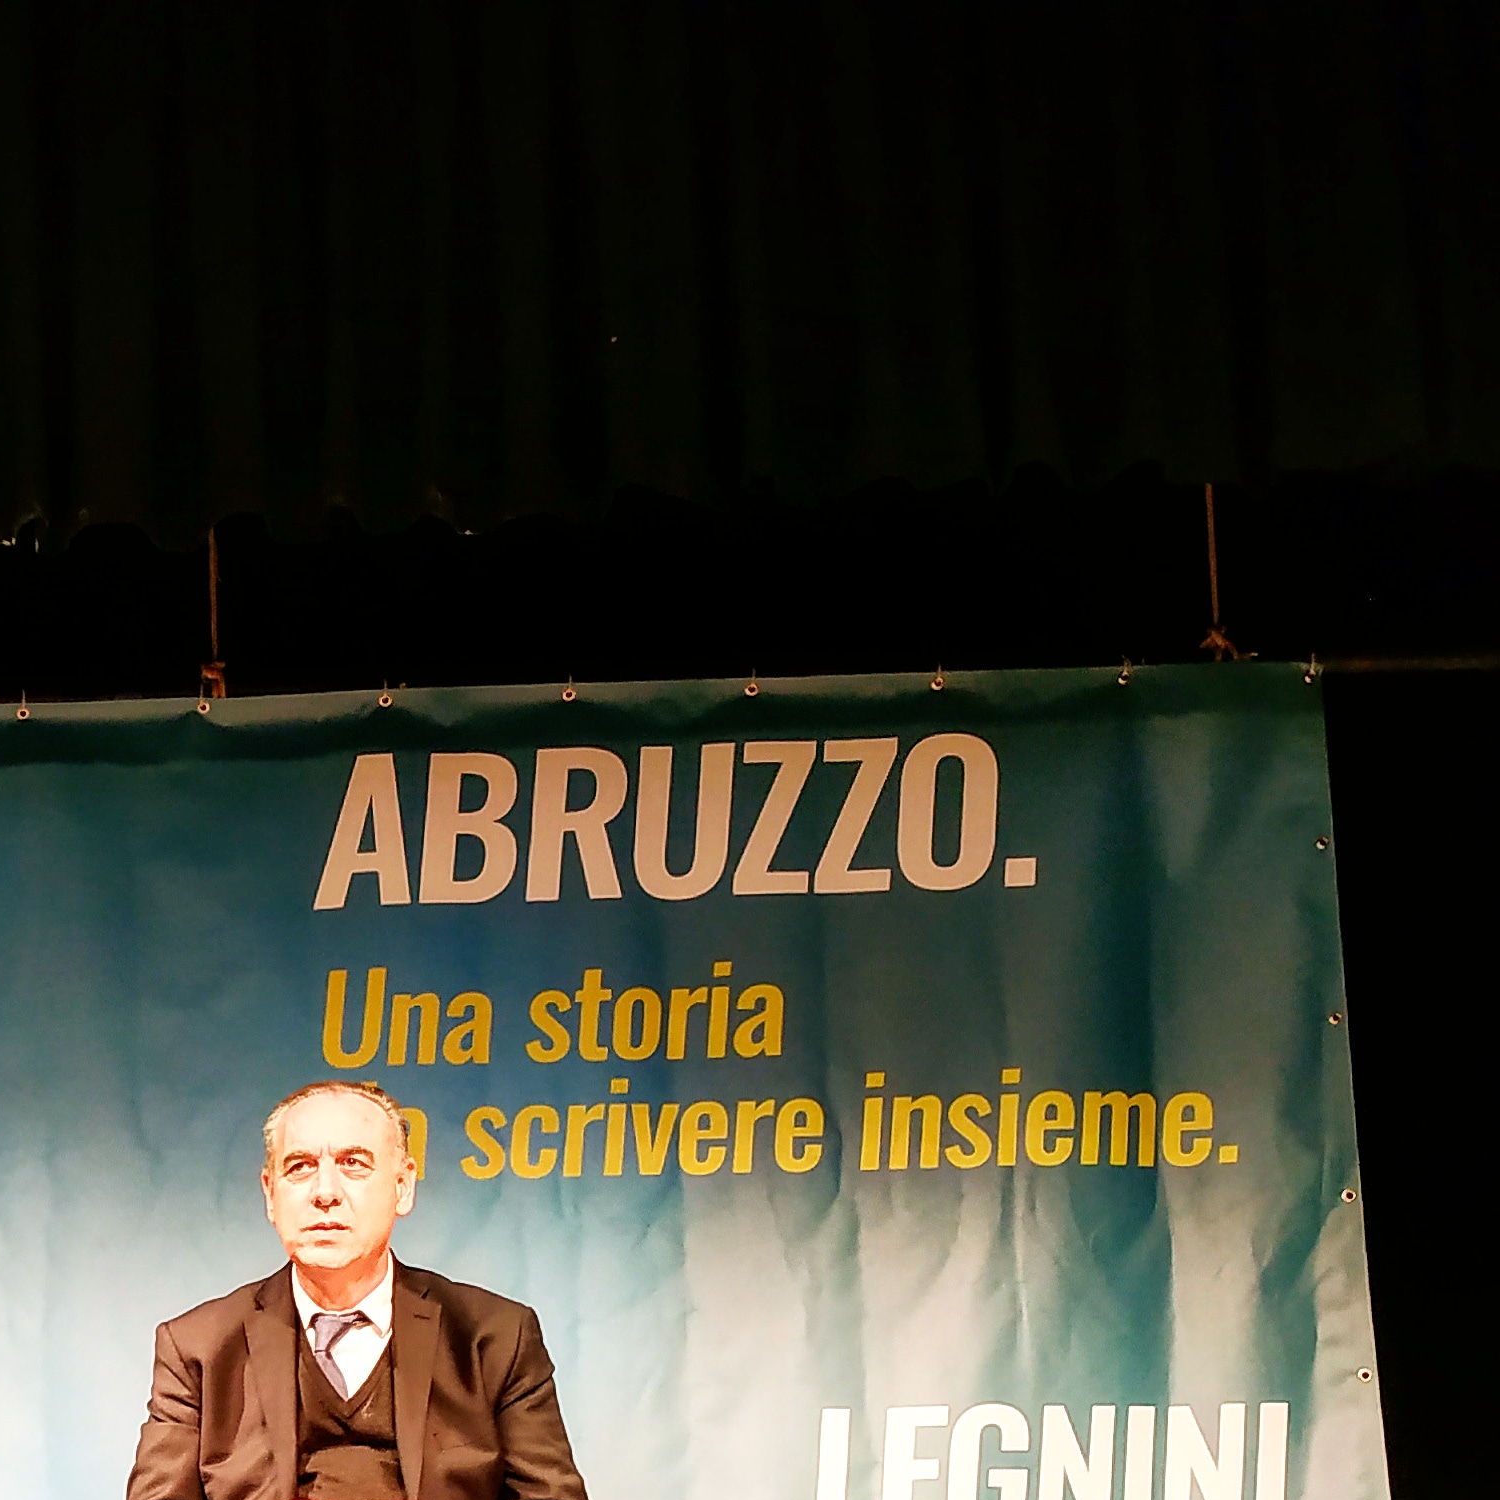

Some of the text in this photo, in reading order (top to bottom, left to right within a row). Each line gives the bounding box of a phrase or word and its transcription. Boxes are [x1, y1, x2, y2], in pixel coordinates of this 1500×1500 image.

[313, 733, 1038, 911] ABRUZZO.
[322, 961, 785, 1069] Una storia
[460, 1078, 823, 1179] scrivere
[859, 1068, 1240, 1173] insieme.
